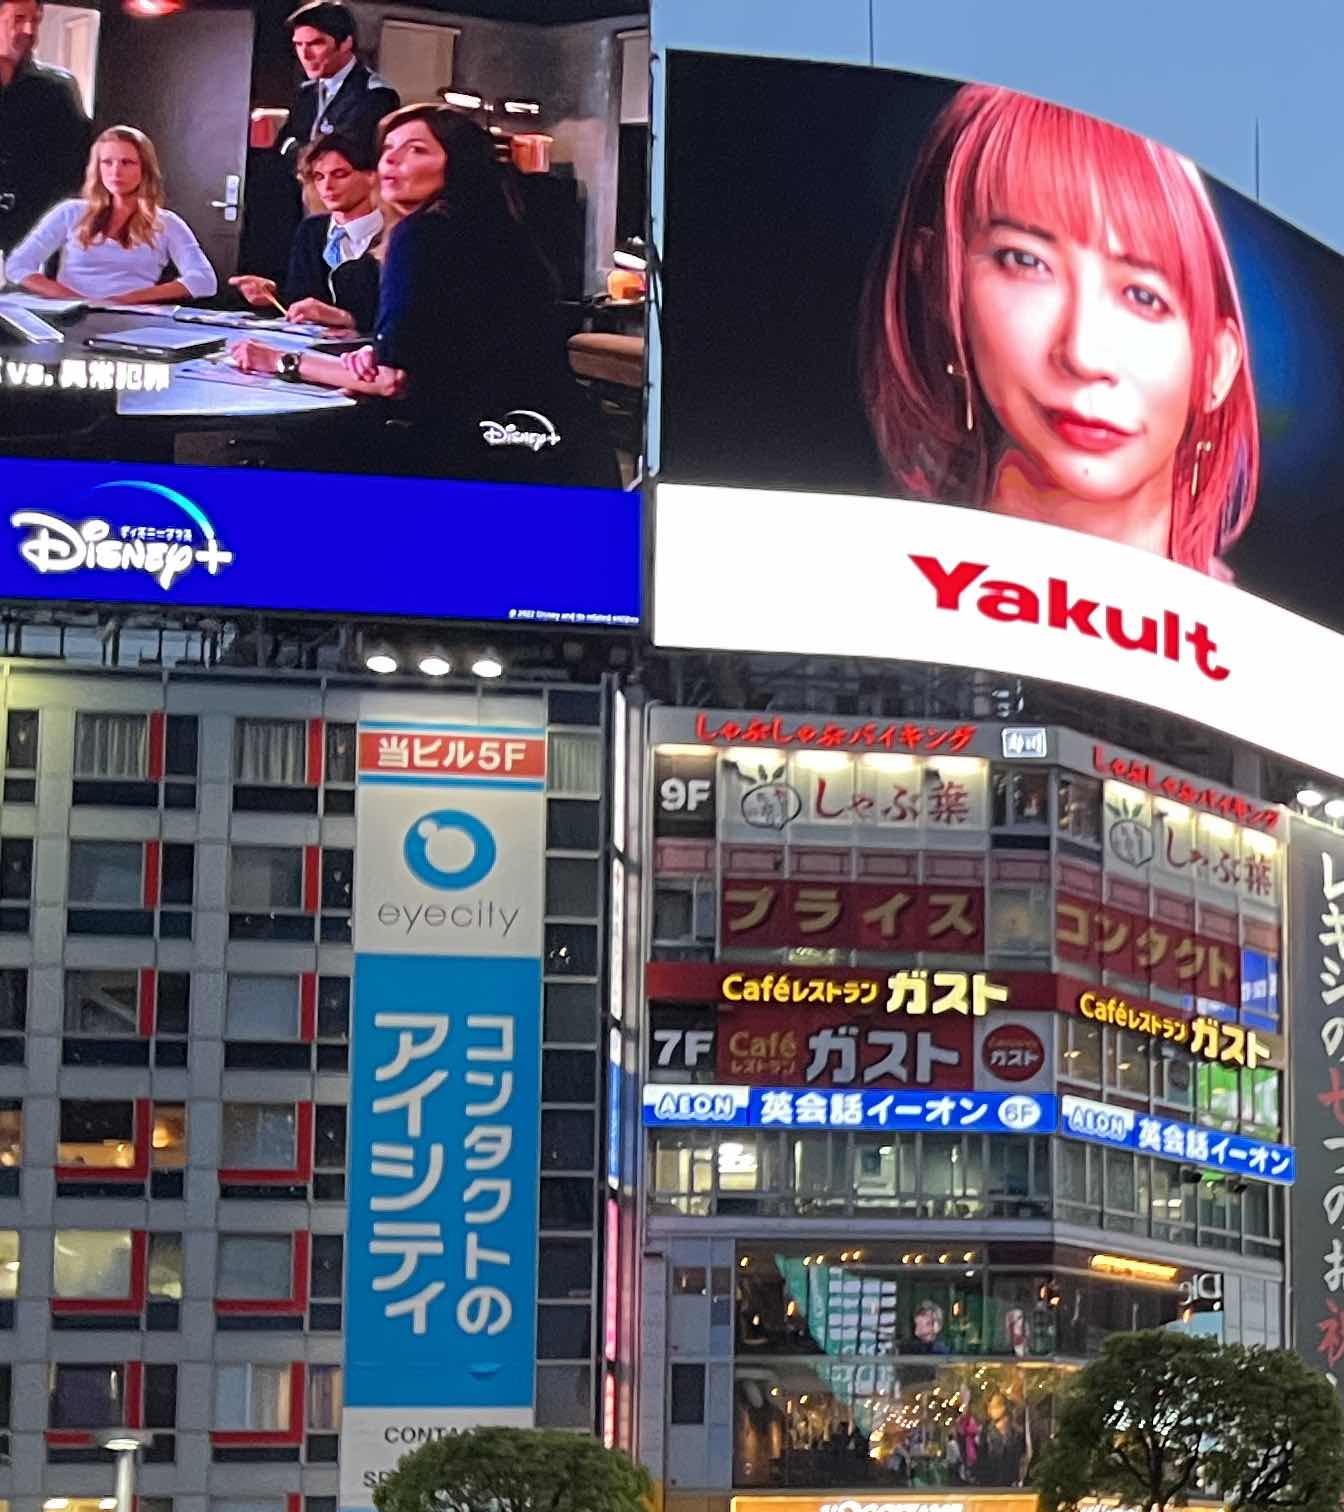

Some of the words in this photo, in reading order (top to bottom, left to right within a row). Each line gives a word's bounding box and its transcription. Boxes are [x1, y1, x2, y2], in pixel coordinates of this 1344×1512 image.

[6, 361, 54, 386] vs.
[479, 420, 561, 451] Disney+
[10, 511, 233, 590] Disney+
[908, 554, 1231, 682] Yakult
[378, 735, 527, 772] 当ビル5F
[696, 714, 977, 751] しゃぶしゃぶバイキング
[660, 776, 713, 812] 9F
[815, 777, 969, 824] しゃぶ葉
[1092, 744, 1280, 832] しゃぶしゃぶバイキング
[1165, 826, 1273, 898] しゃぶ葉
[378, 900, 519, 937] eyecity
[1055, 900, 1236, 987] コンタクト
[886, 969, 1009, 1016] ガスト
[653, 1029, 714, 1068] 7F
[728, 1030, 798, 1058] Café
[805, 1026, 960, 1084] ガスト
[989, 1050, 1040, 1068] ガスト
[1190, 1016, 1271, 1069] ガスト
[656, 1094, 738, 1120] AEON
[761, 1091, 988, 1126] 英会話イーオン
[1003, 1101, 1036, 1123] 6F
[1069, 1105, 1127, 1139] AEON
[1137, 1117, 1290, 1176] 英会話イーオン
[369, 1011, 450, 1335] アイシティ
[456, 1012, 514, 1335] コンタクトの
